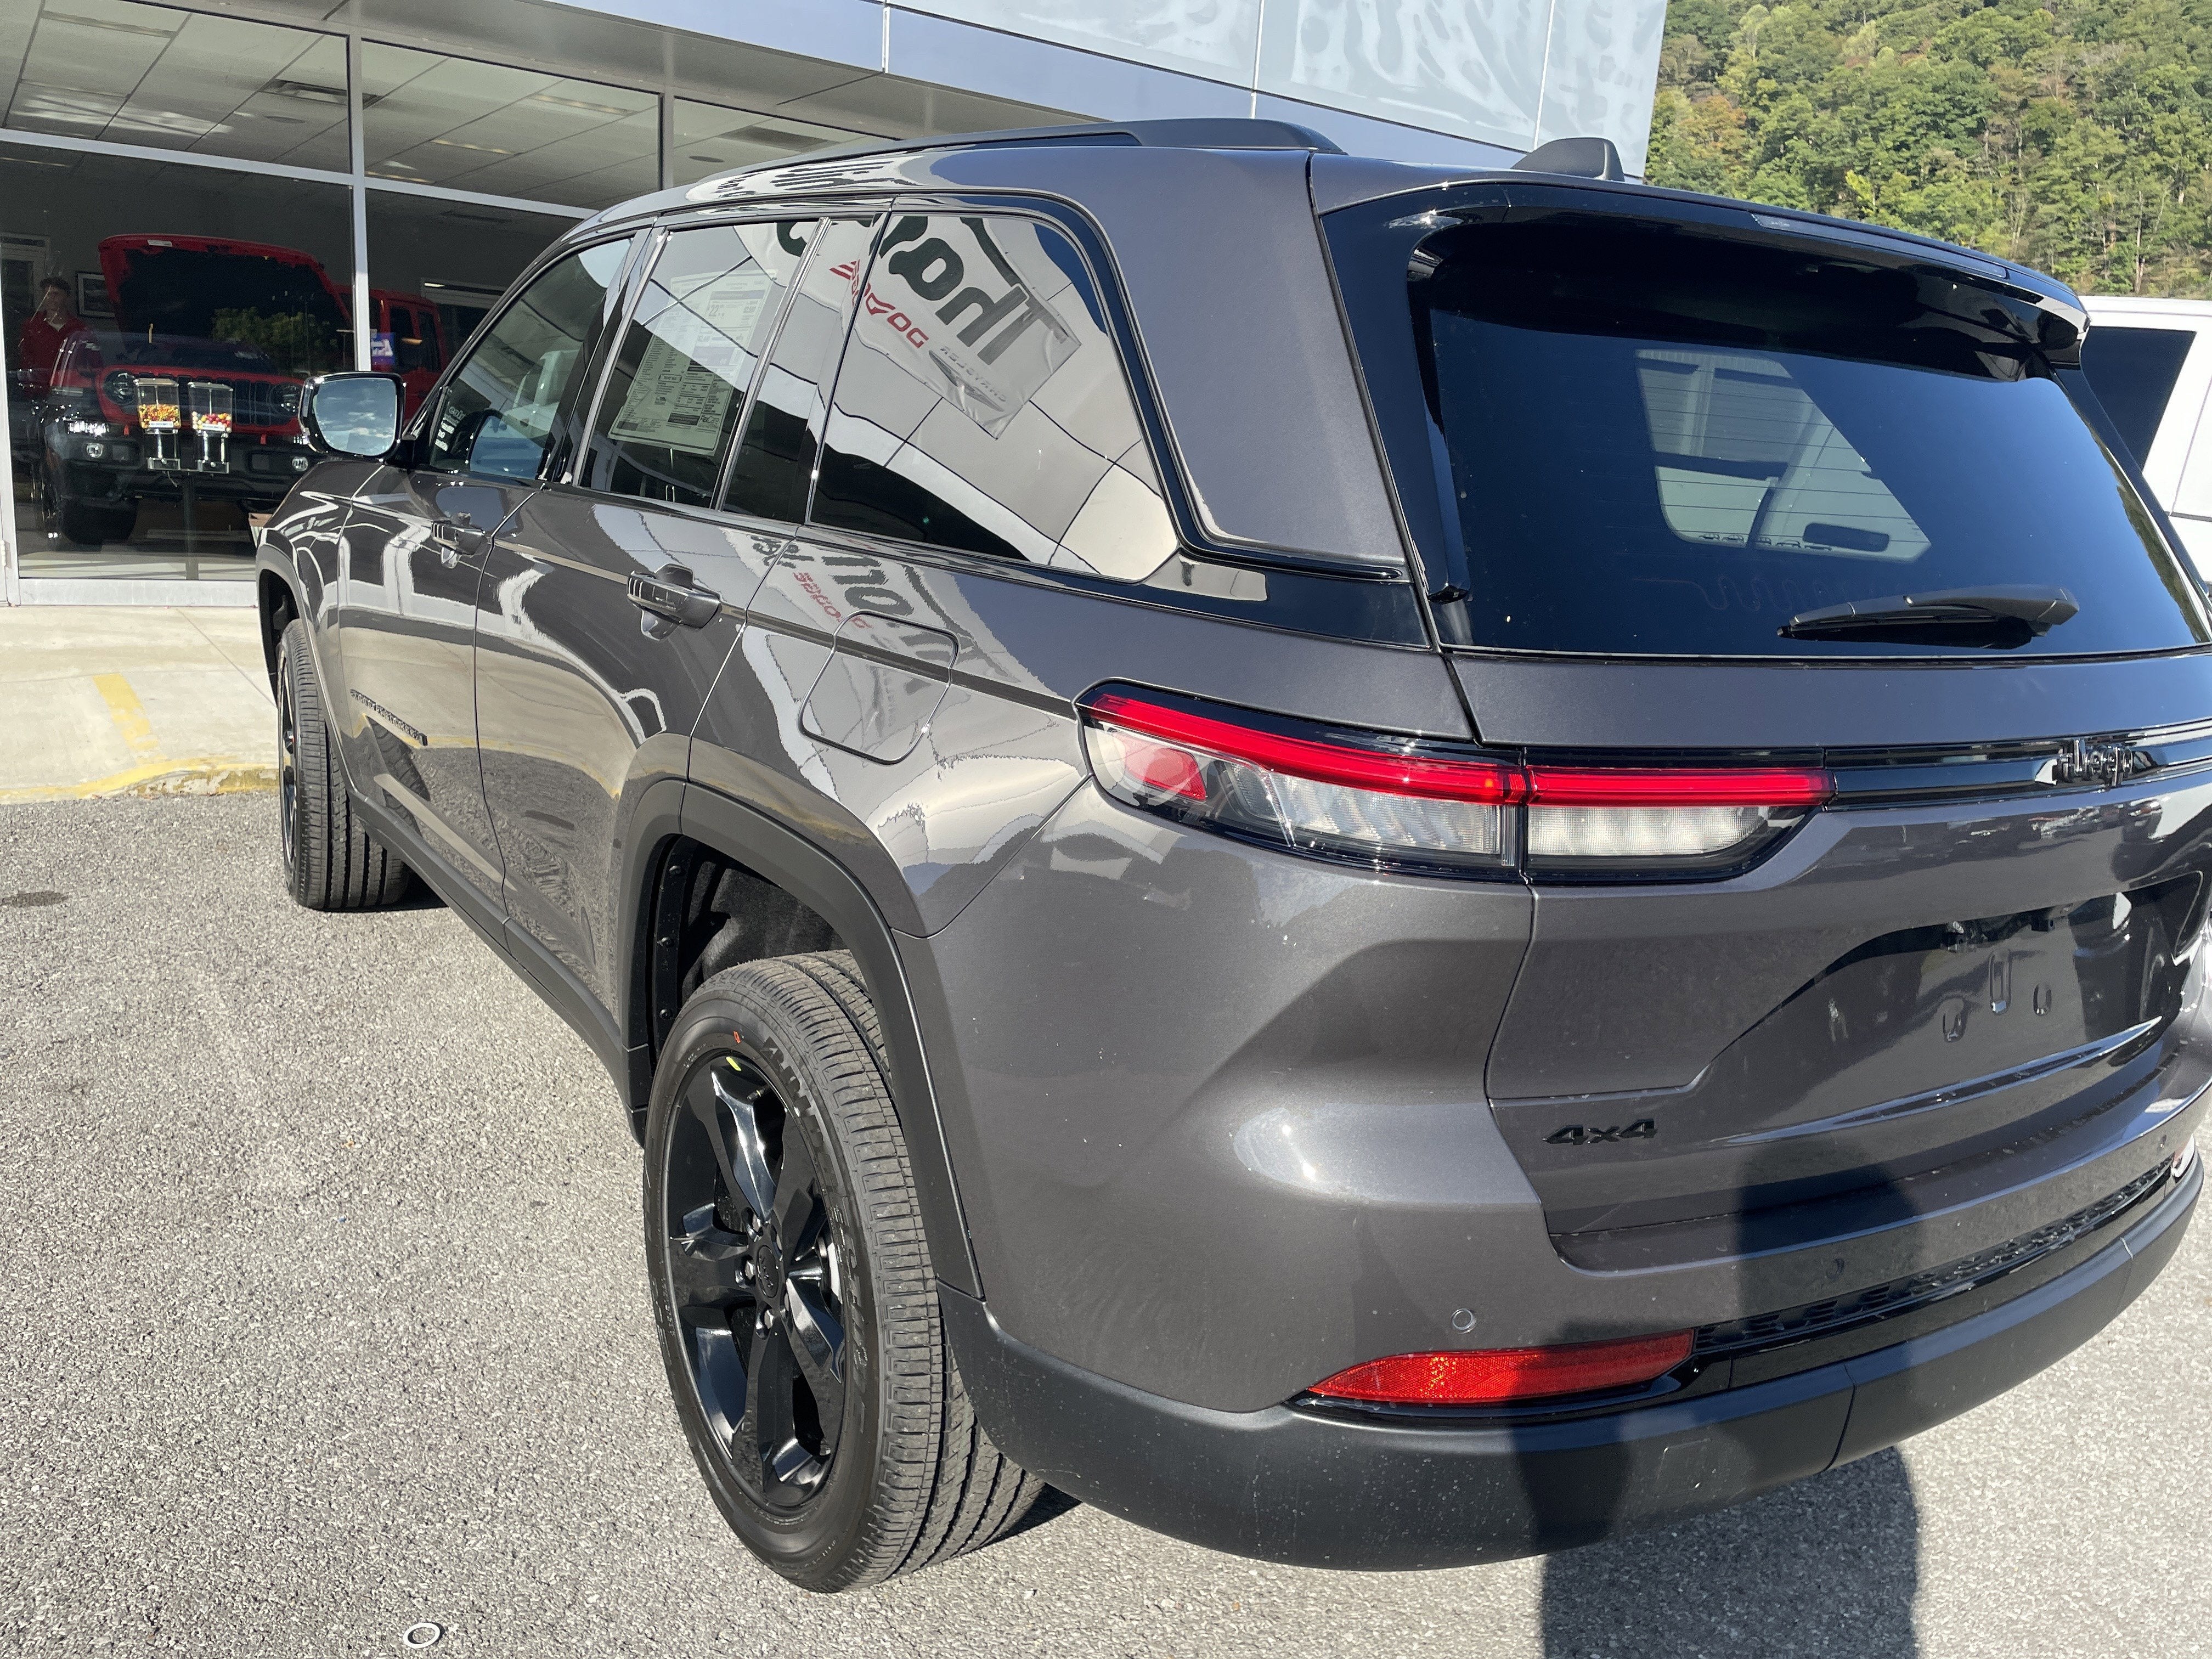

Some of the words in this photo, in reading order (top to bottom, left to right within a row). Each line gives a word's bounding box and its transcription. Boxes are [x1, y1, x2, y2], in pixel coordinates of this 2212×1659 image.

[2059, 738, 2134, 787] Jeep
[1542, 1118, 1658, 1146] 4x4
[760, 1036, 867, 1434] BRIDGESTONE
